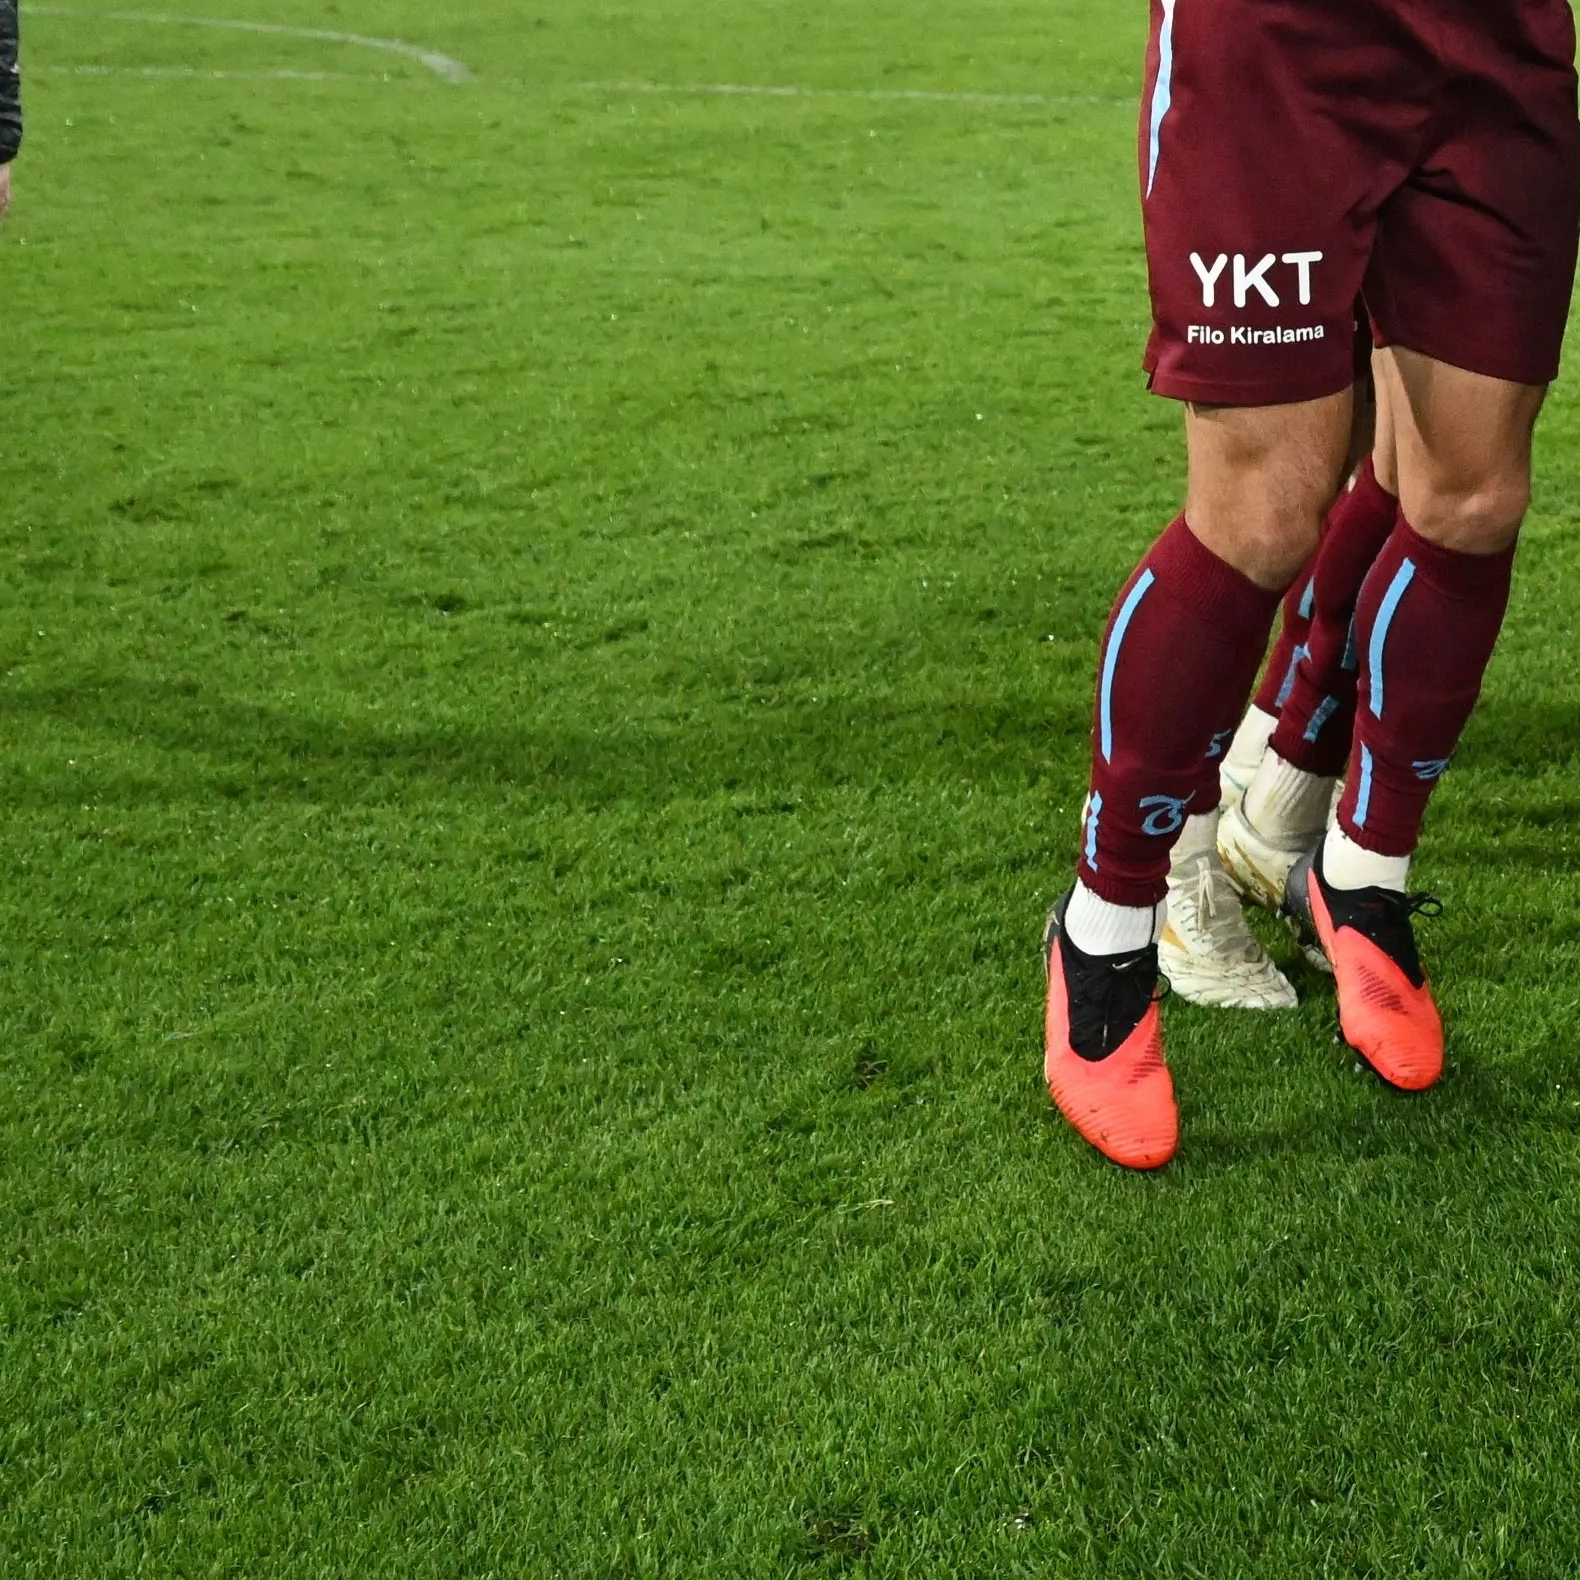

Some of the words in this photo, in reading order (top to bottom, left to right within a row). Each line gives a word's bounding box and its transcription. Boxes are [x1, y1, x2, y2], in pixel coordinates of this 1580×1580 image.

[1190, 251, 1323, 308] YKT
[1187, 325, 1225, 345] Filo
[1230, 323, 1324, 345] Kiralama
